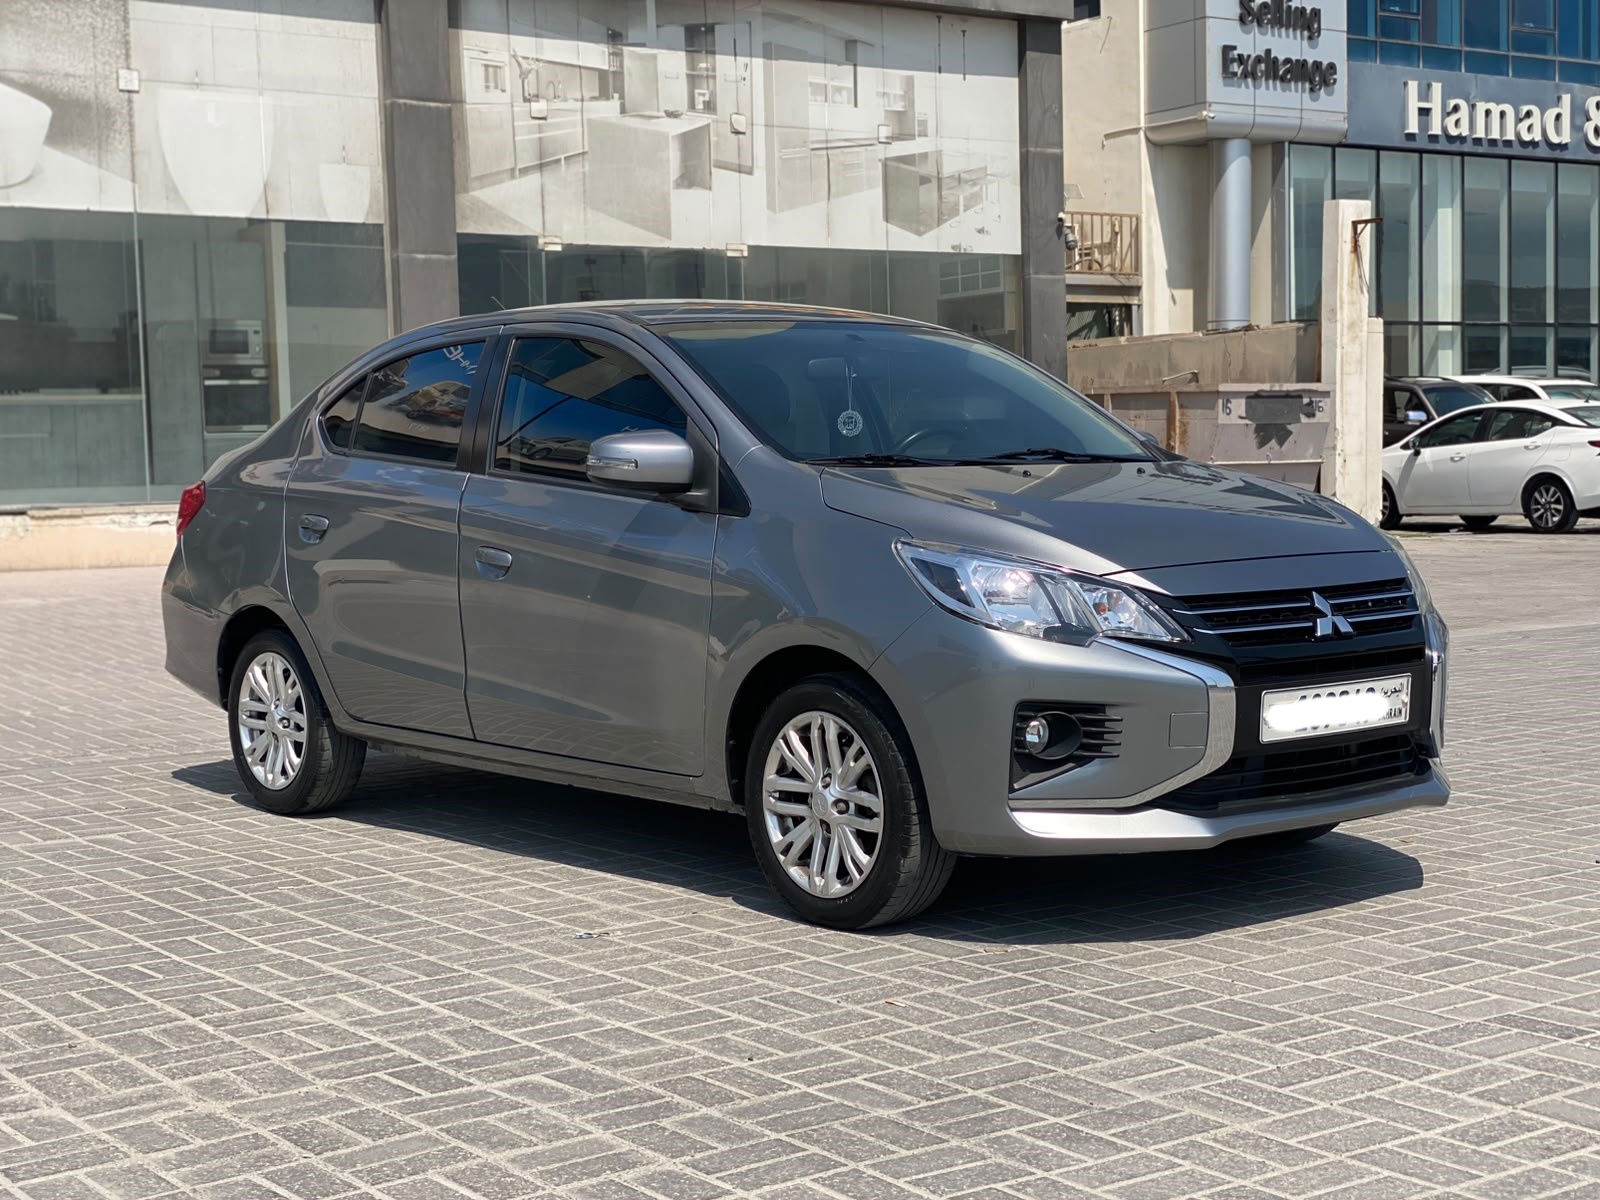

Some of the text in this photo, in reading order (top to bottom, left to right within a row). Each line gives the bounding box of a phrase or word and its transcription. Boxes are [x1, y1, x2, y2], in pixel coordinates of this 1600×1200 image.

[1239, 0, 1321, 40] Selling
[1221, 45, 1337, 93] Exchange
[1403, 80, 1571, 145] Hamad
